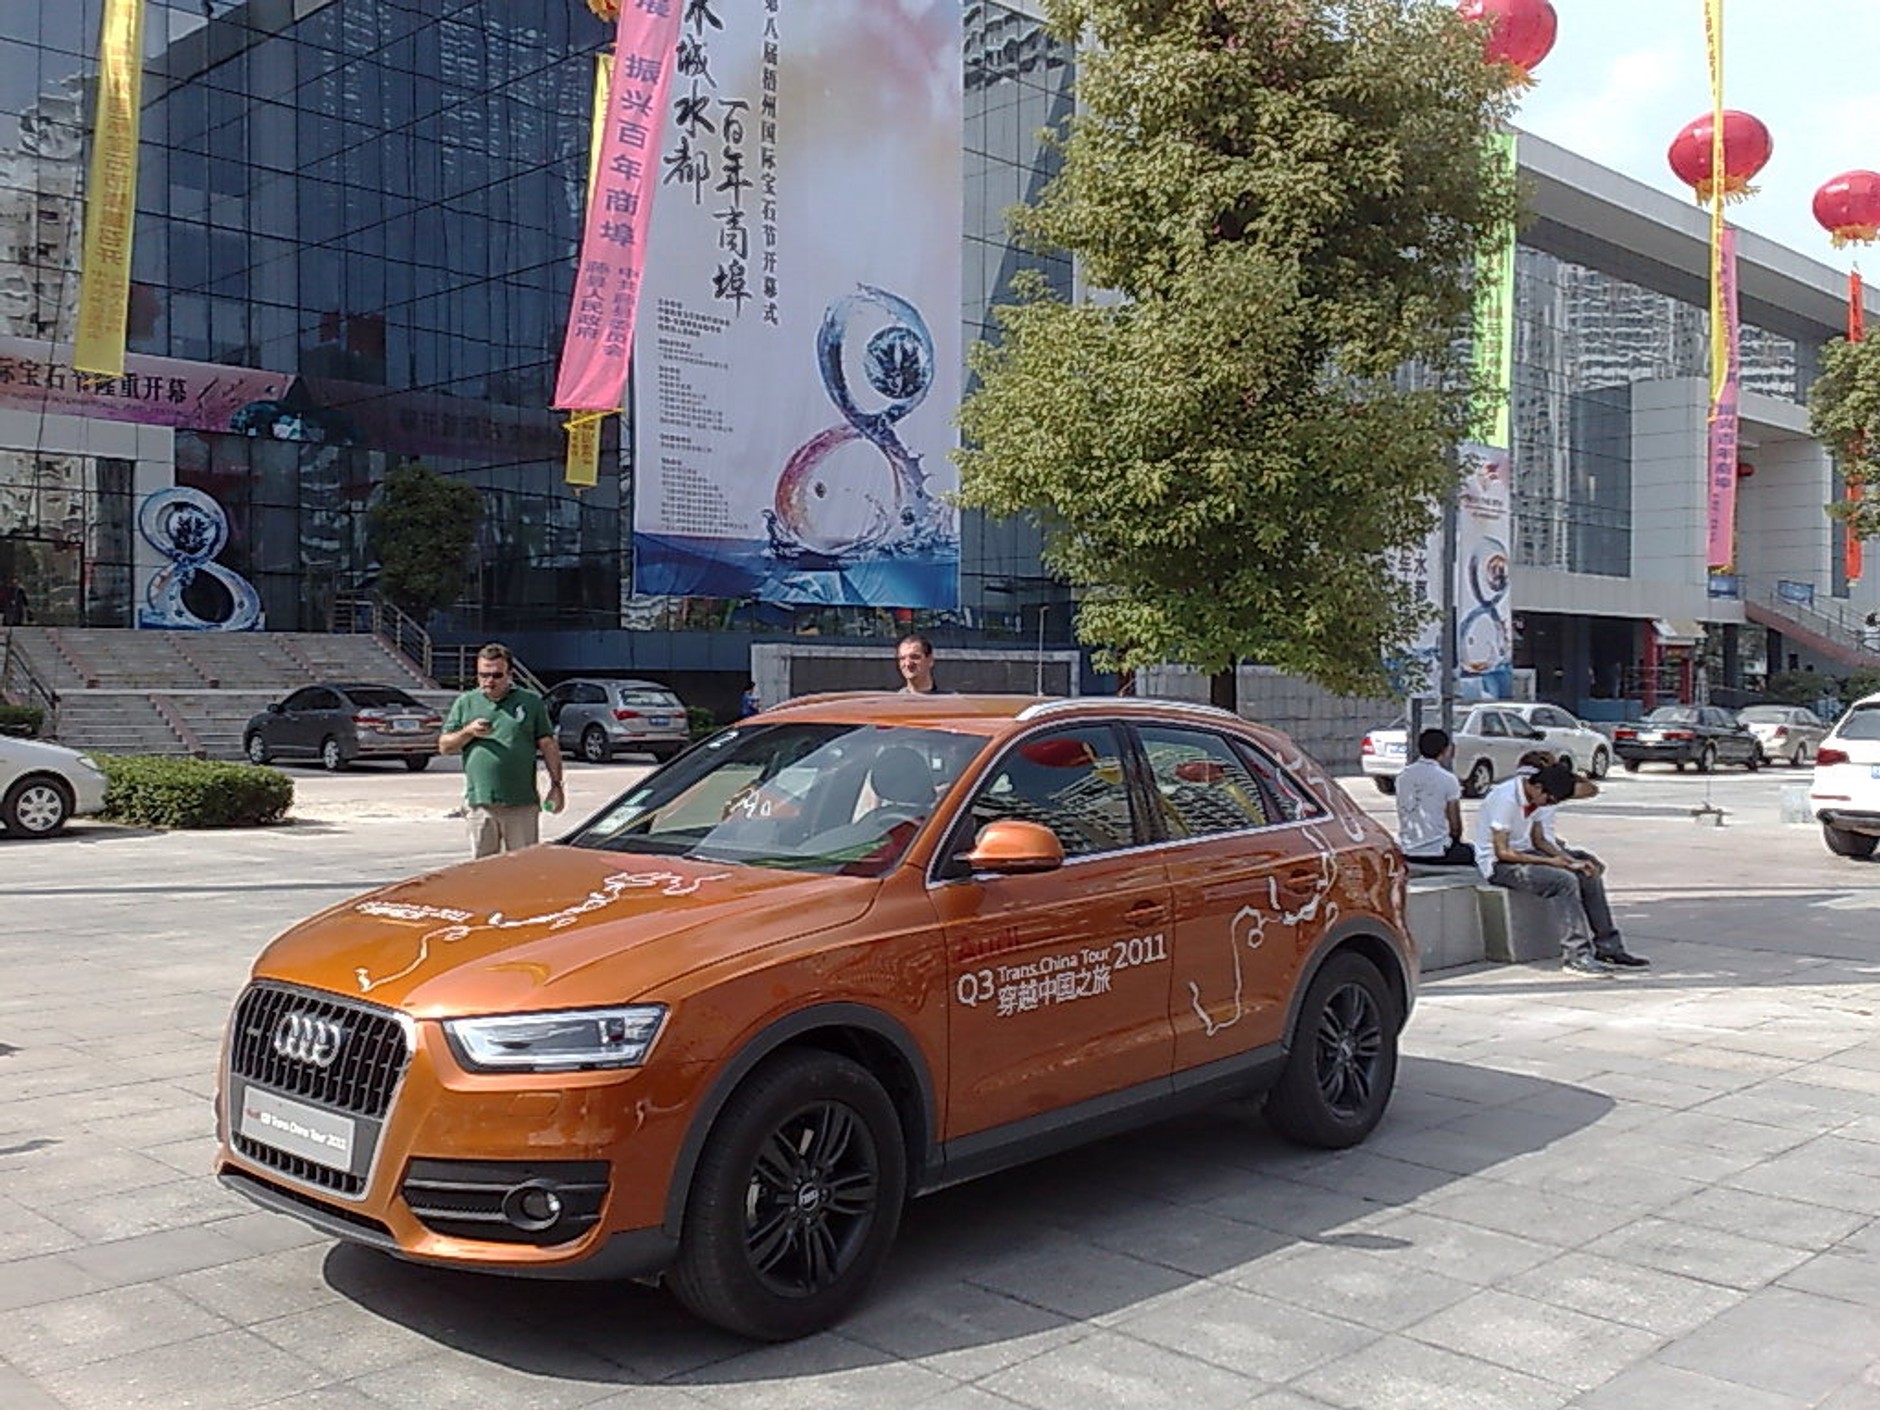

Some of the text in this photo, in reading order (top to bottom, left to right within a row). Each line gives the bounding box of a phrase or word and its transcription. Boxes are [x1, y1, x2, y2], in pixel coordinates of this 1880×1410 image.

[600, 53, 663, 247] 振兴百年商埠
[712, 98, 754, 319] 百年商埠
[957, 933, 1168, 1007] Q3 Trans China Tour 2011
[996, 965, 1112, 1017] 穿越中国之旅
